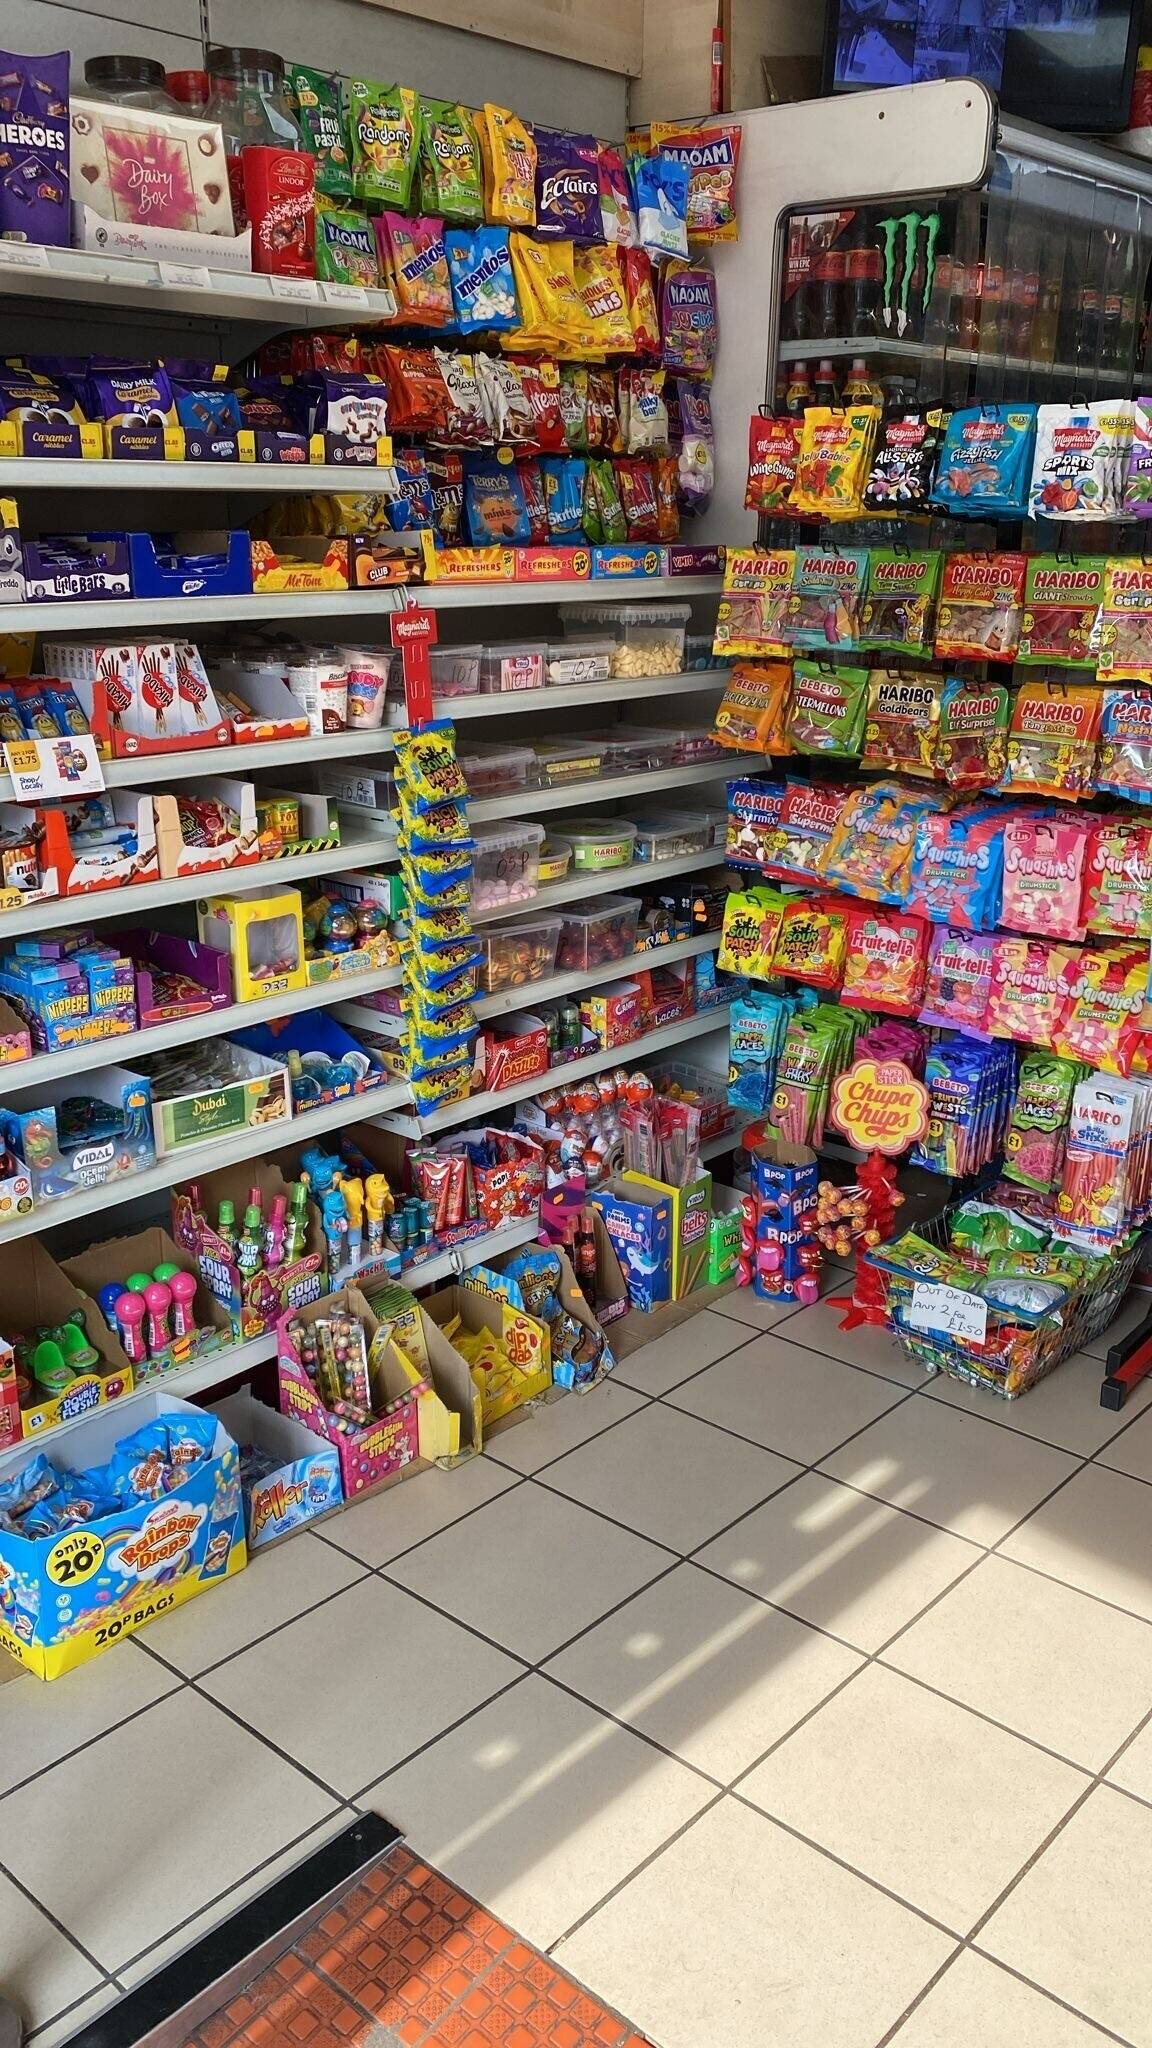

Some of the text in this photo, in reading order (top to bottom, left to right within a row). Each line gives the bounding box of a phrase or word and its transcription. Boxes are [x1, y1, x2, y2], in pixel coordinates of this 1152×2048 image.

[358, 123, 410, 150] Randoms
[665, 143, 729, 166] MAOAM
[122, 159, 173, 199] Dairy
[278, 177, 304, 188] LINDOR
[138, 185, 168, 214] Box
[542, 177, 597, 209] Eclairs
[401, 242, 444, 282] mentos
[456, 248, 509, 299] mentos
[643, 406, 656, 417] bar
[32, 432, 73, 443] Caramel
[120, 435, 157, 445] Caramel
[813, 427, 849, 442] Maynards
[885, 423, 926, 440] Maynards
[962, 424, 1005, 439] Maynards
[1054, 430, 1099, 447] Maynards
[212, 441, 235, 452] OREO
[756, 440, 794, 453] Maynards
[820, 449, 851, 464] Babies
[876, 451, 925, 464] ALLSORTS
[1043, 456, 1094, 471] SPORTS
[750, 461, 796, 480] Wine Gums
[1056, 467, 1078, 476] MIX
[484, 507, 511, 519] minis
[450, 562, 500, 573] REFRESHERS
[520, 560, 572, 570] REFRESHERS
[598, 559, 643, 569] REFRESHERS
[732, 560, 789, 576] HARIBO
[802, 559, 857, 576] HARIBO
[875, 563, 927, 579] HARIBO
[369, 566, 388, 580] CLUB
[952, 566, 1013, 586] HARIBO
[1034, 571, 1100, 589] HARIBO
[54, 574, 105, 594] Little Bars
[994, 592, 1014, 601] ZING
[1034, 592, 1061, 601] GIANT
[396, 617, 430, 636] Maynards
[102, 676, 132, 710] MIKADO
[143, 673, 173, 708] MIKADO
[736, 679, 770, 694] BEBETO
[800, 678, 841, 696] BEBETO
[878, 685, 935, 705] HARIBO
[879, 704, 929, 716] Goldbears
[949, 697, 998, 718] HARIBO
[1023, 701, 1085, 723] HARIBO
[718, 715, 728, 723] £1
[961, 718, 995, 729] Surprises
[14, 755, 37, 766] £1.75
[420, 754, 451, 774] SOUR
[20, 776, 35, 784] Shop
[427, 764, 460, 788] PATCH
[21, 782, 44, 790] Locally
[733, 791, 784, 814] HARIBO
[844, 809, 914, 845] Squashies
[1009, 831, 1029, 840] £1.15
[593, 846, 623, 857] HARIBO
[915, 839, 990, 870] Squashies
[1006, 846, 1076, 880] Squashies
[925, 868, 967, 879] DRUMSTICK
[1019, 881, 1057, 890] DRUMSTICK
[729, 924, 760, 941] SOUR
[785, 930, 818, 943] SOUR
[725, 937, 757, 951] PATCH
[784, 942, 817, 952] PATCH
[851, 929, 915, 957] Fruit-tella
[996, 962, 1069, 996] Squashies
[94, 987, 135, 1008] NIPPERS
[1069, 976, 1144, 1014] Squashies
[47, 995, 89, 1018] NIPPERS
[615, 999, 637, 1016] CANDY
[1078, 1009, 1119, 1021] DRUMSTICK
[655, 1007, 680, 1024] Laces
[738, 1020, 767, 1030] BEBETO
[736, 1040, 764, 1050] LACES
[788, 1044, 819, 1058] BEBETO
[502, 1055, 540, 1080] DAZZLER
[878, 1075, 904, 1084] STICK
[933, 1078, 969, 1093] BEBETO
[1025, 1081, 1059, 1094] BEBETO
[776, 1095, 786, 1104] £1
[849, 1082, 914, 1106] Chupa
[192, 1094, 227, 1116] Dubai
[299, 1096, 324, 1110] millions
[1023, 1103, 1054, 1116] LACES
[844, 1102, 910, 1129] Chups
[929, 1122, 941, 1131] £1
[1008, 1136, 1020, 1146] £1
[77, 1147, 112, 1165] VIDAL
[80, 1165, 109, 1179] Ocean
[85, 1173, 105, 1185] Jelly
[607, 1220, 631, 1233] CANDY
[682, 1212, 708, 1236] belts
[683, 1230, 705, 1244] Rainbow
[200, 1256, 230, 1282] SOUR
[203, 1275, 232, 1299] SPRAY
[288, 1276, 320, 1297] SOUR
[916, 1283, 985, 1310] OUT OF DATE
[913, 1301, 938, 1311] ANY
[941, 1303, 950, 1316] 2
[946, 1316, 983, 1336] £1.50
[506, 1328, 527, 1351] dip
[509, 1347, 533, 1366] dab
[64, 1386, 97, 1408] DOUBLE
[31, 1417, 42, 1427] £1
[360, 1422, 404, 1453] BUBBLEGUM
[368, 1437, 395, 1459] STRIPS
[54, 1536, 88, 1558] only
[119, 1515, 201, 1566] Rainbow
[137, 1534, 190, 1572] Drops
[54, 1543, 102, 1584] 20p
[134, 1593, 175, 1624] BAGS
